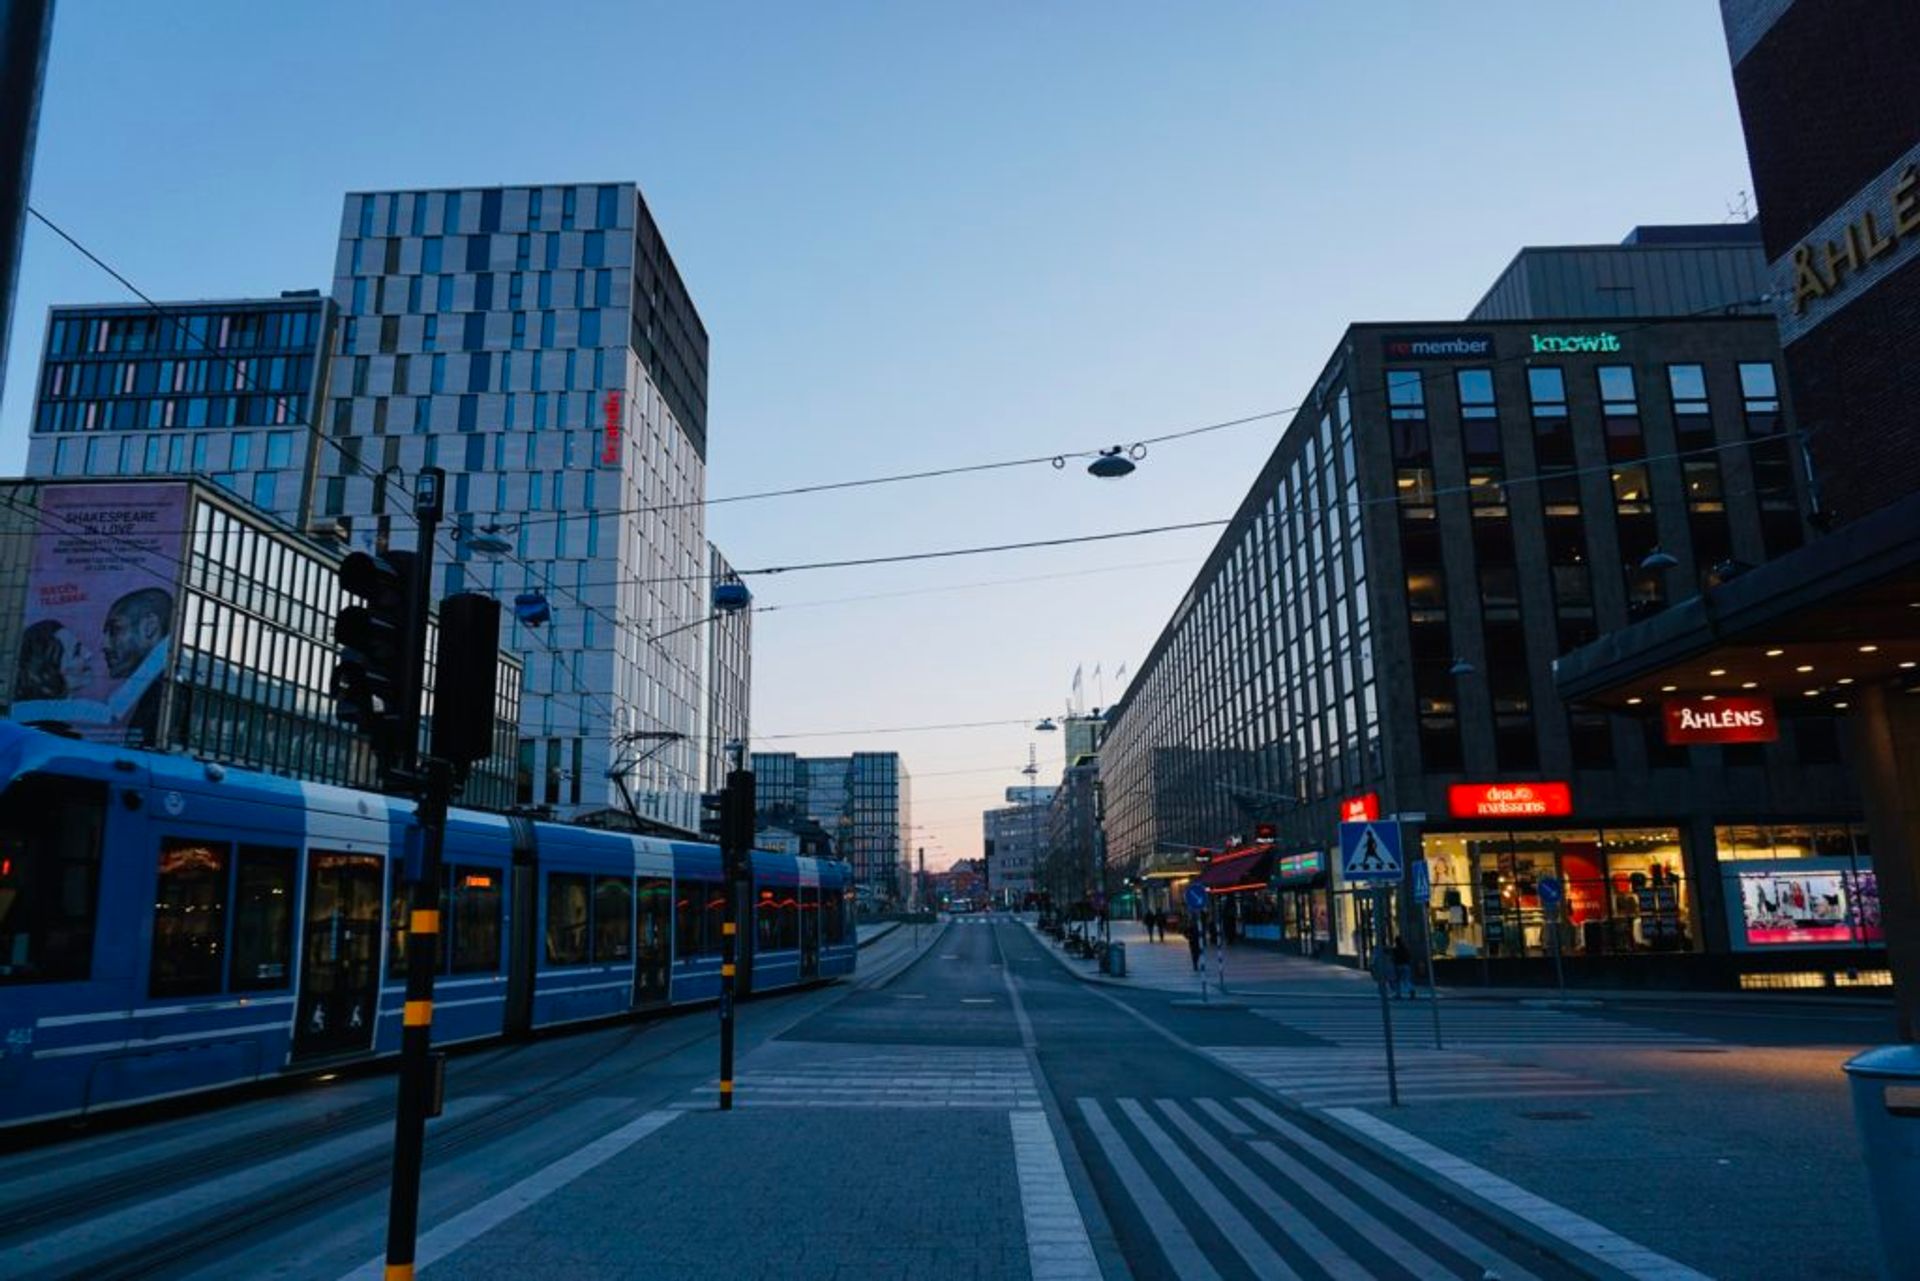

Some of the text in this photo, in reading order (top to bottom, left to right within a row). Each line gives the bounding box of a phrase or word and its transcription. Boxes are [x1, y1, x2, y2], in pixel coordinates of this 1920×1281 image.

[1391, 337, 1489, 355] remember
[1531, 333, 1621, 352] knowit
[66, 510, 158, 524] SHAKESPEARE
[84, 523, 136, 535] IN LOVE
[1680, 708, 1763, 729] ÅHLÉNS
